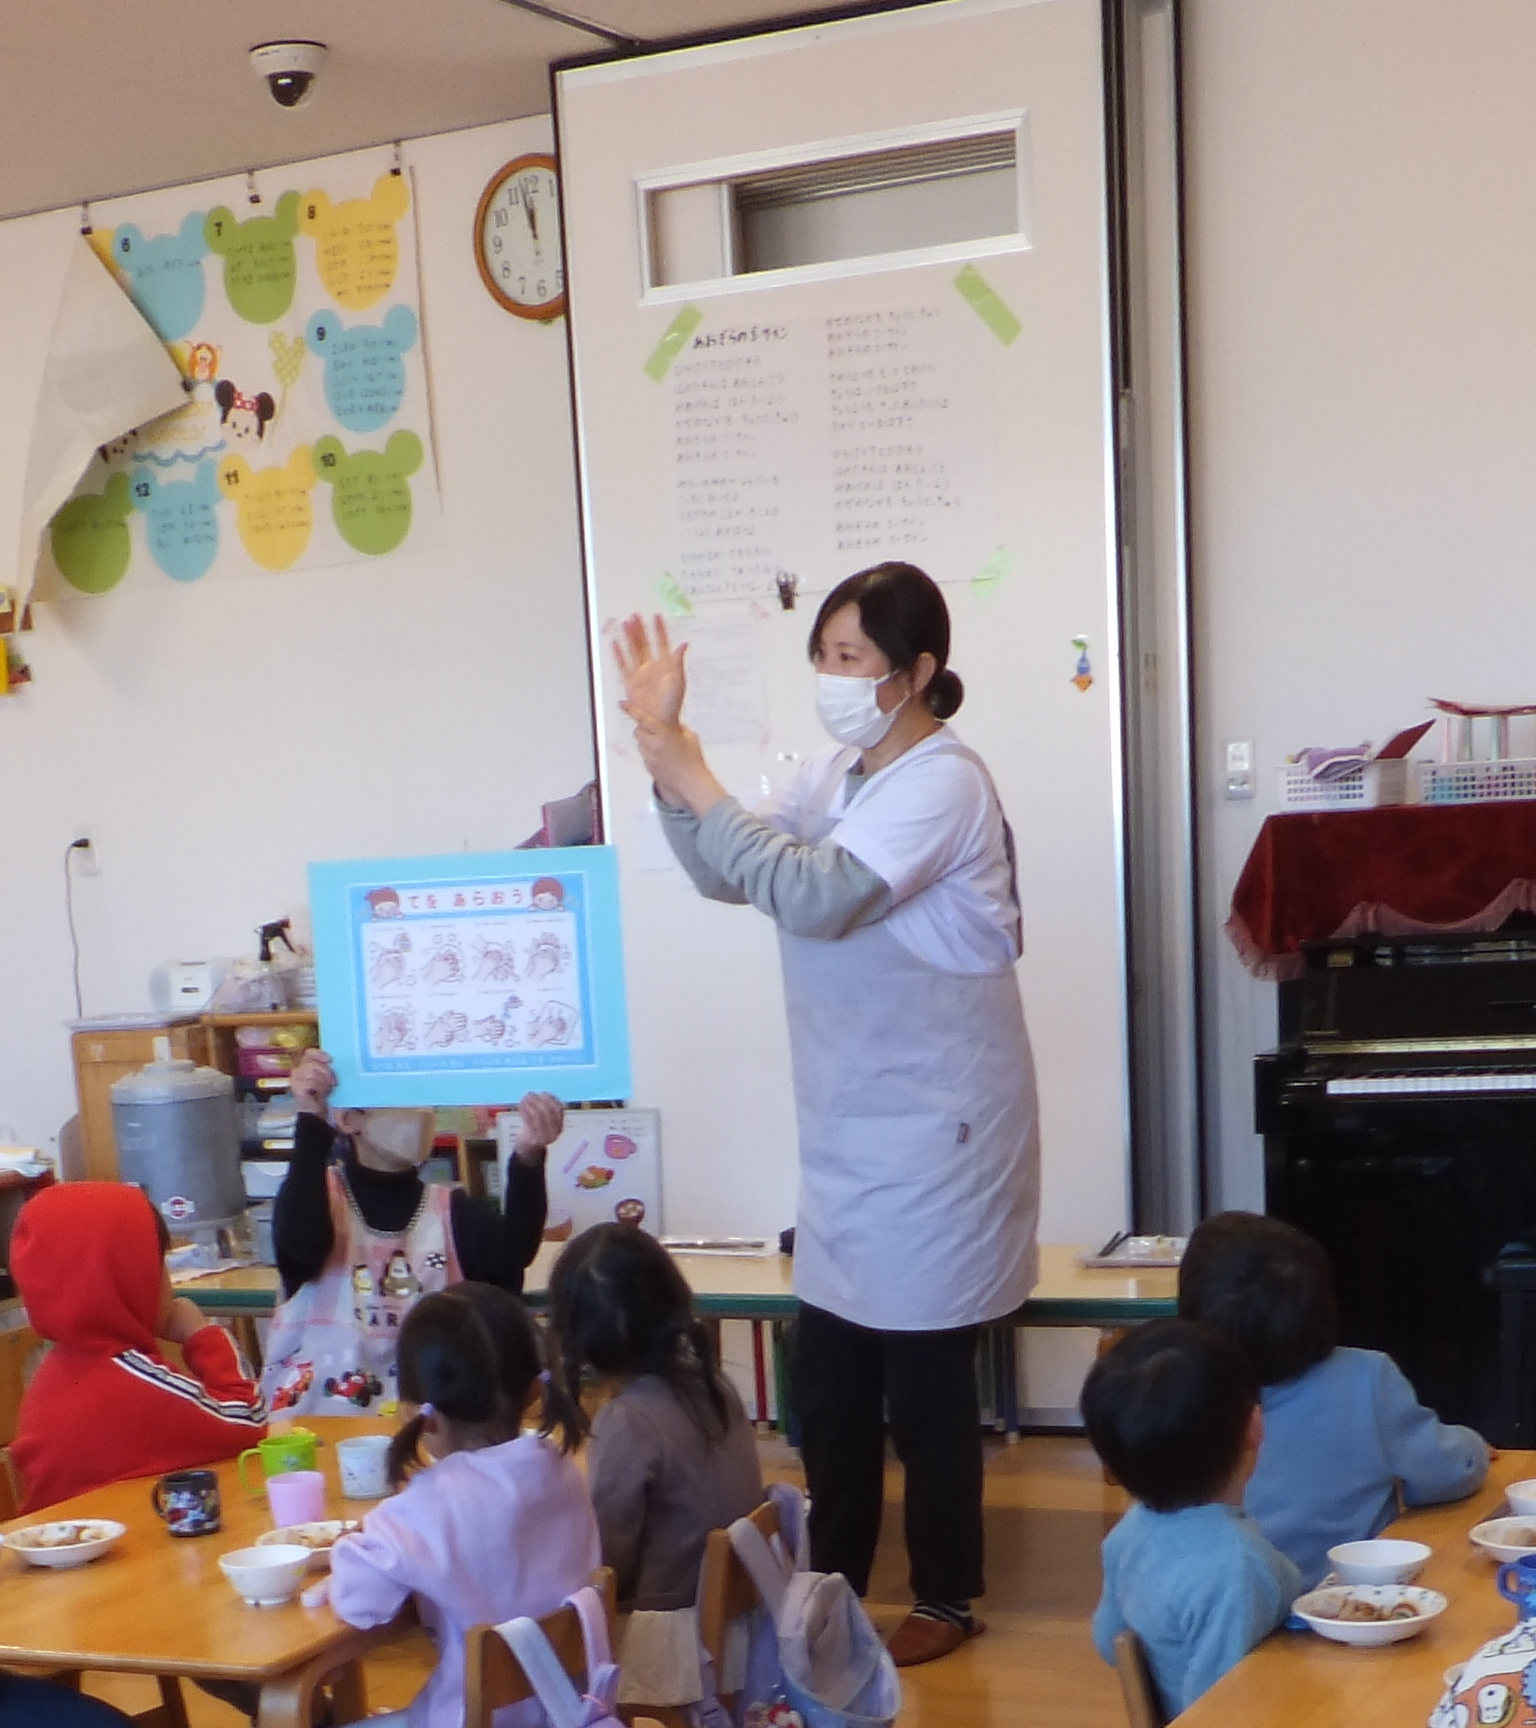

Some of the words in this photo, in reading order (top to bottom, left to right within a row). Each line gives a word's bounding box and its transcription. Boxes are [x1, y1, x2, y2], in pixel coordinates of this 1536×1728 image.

[524, 175, 539, 194] 12
[494, 208, 509, 228] 10
[493, 236, 503, 254] 9
[502, 261, 512, 279] 8
[519, 276, 526, 295] 7
[537, 280, 547, 298] 6
[225, 469, 239, 486] 11
